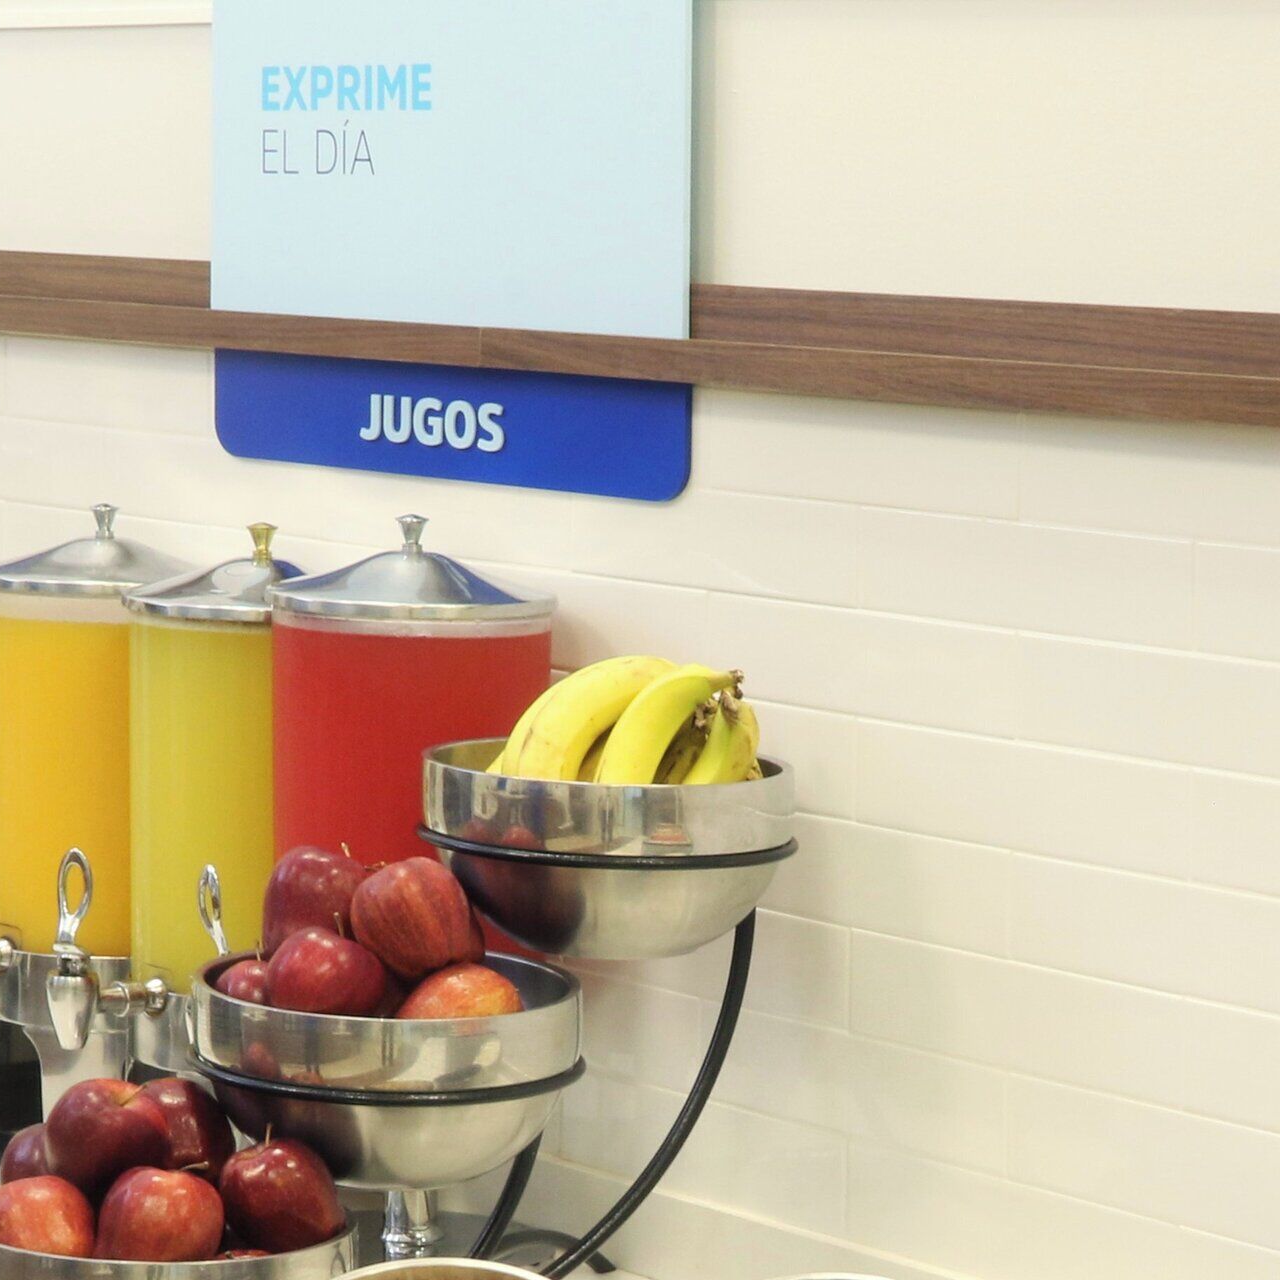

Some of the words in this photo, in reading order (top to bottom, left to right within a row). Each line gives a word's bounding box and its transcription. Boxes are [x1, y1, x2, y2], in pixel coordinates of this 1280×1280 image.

[261, 63, 433, 112] EXPRIME
[261, 129, 299, 175] EL
[315, 120, 376, 176] DÍA
[359, 393, 506, 453] JUGOS
